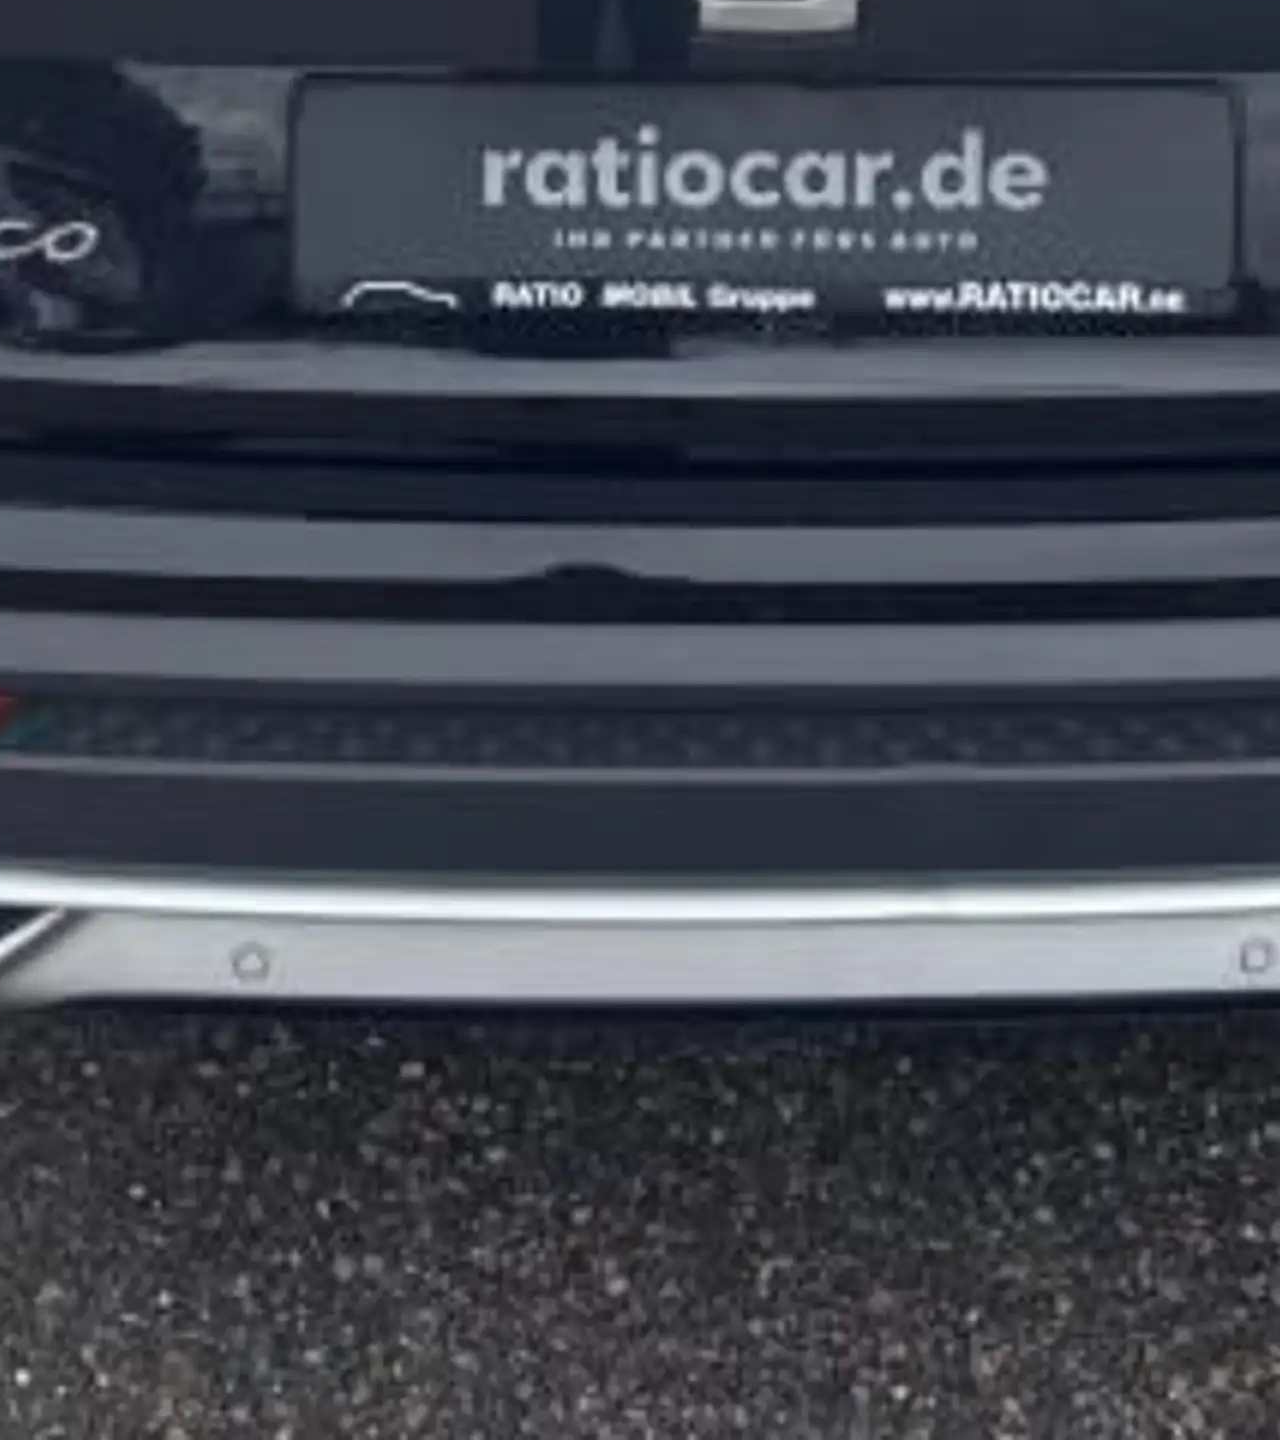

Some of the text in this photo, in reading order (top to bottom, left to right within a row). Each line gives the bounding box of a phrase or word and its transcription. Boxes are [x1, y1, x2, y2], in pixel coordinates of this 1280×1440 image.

[483, 127, 1050, 210] ratiocar.de
[490, 279, 583, 309] RATIO
[601, 279, 698, 309] MOBIL
[705, 278, 817, 314] Gruppe
